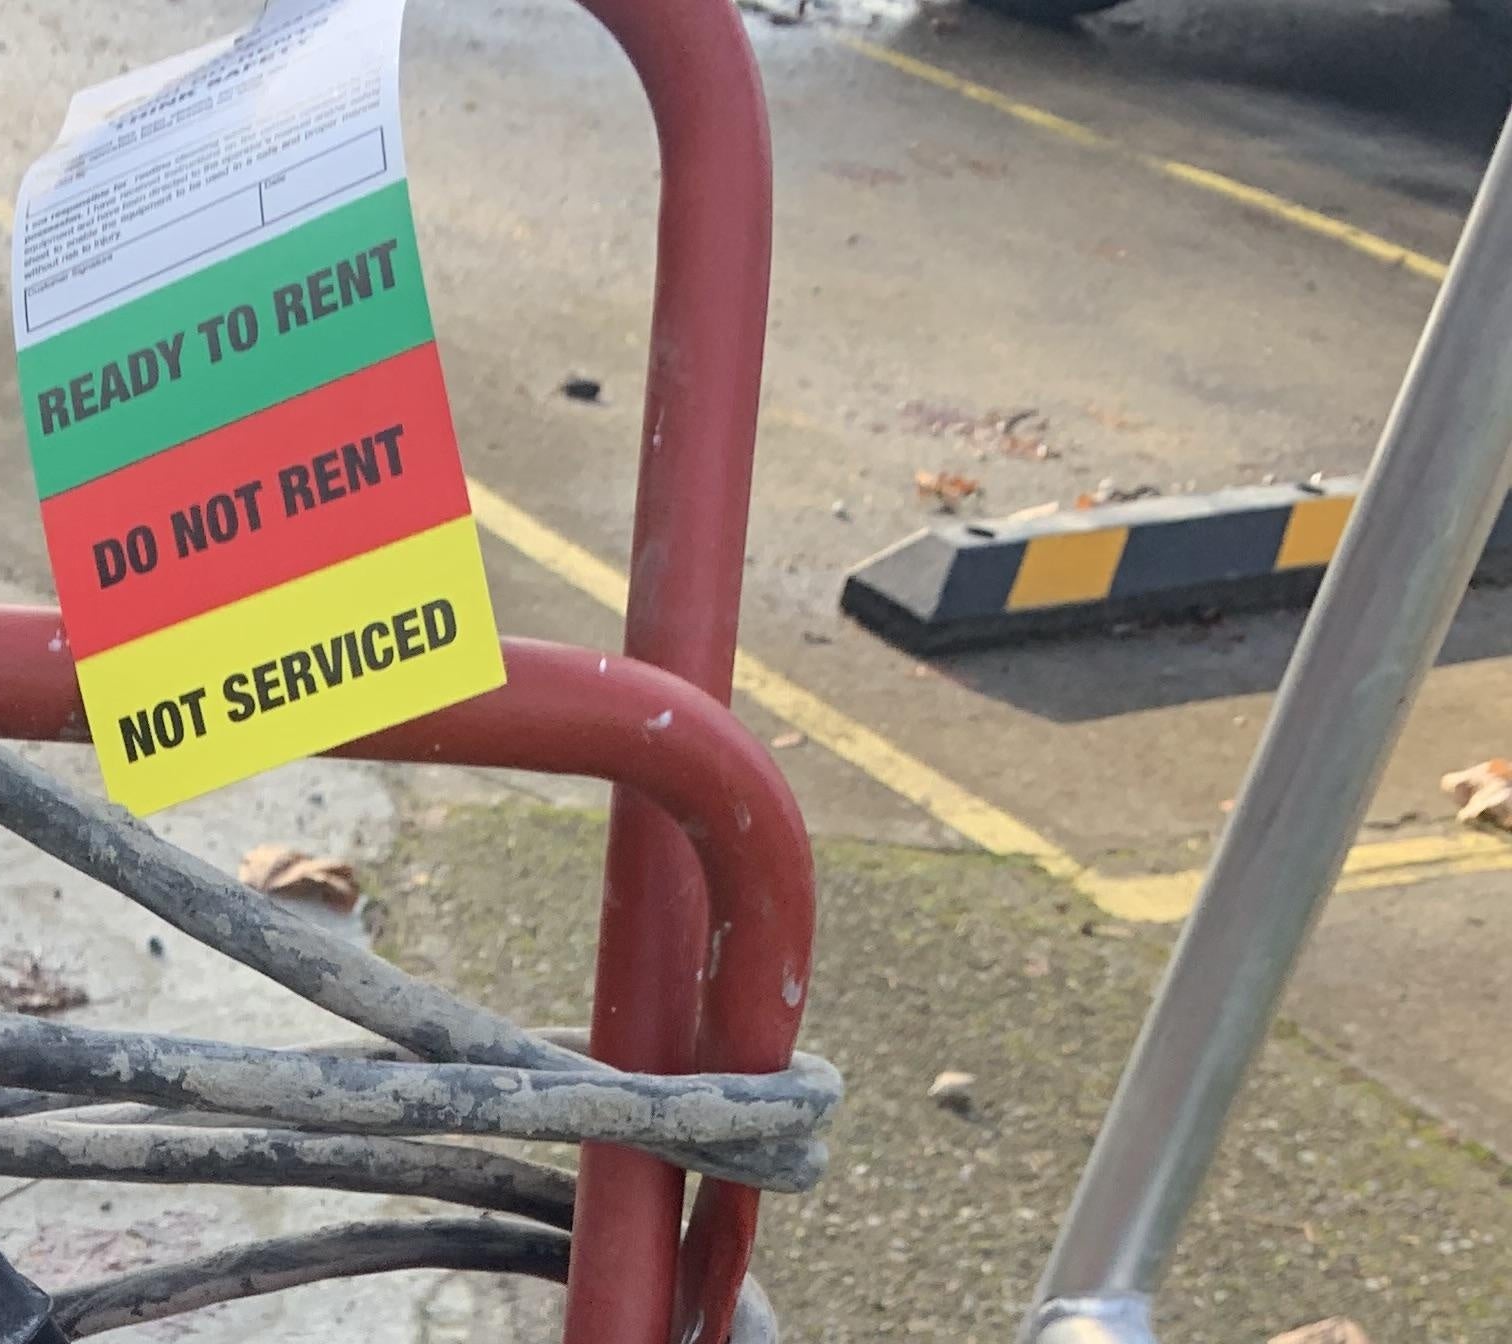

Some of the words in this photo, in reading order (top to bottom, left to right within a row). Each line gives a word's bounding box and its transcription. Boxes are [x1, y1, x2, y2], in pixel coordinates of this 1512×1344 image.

[38, 331, 183, 436] READY
[198, 304, 258, 364] TO
[274, 239, 399, 335] RENT
[92, 525, 159, 589] DO
[171, 480, 264, 559] NOT
[279, 424, 405, 518] RENT
[118, 688, 208, 764] NOT
[222, 598, 458, 724] SERVICED
